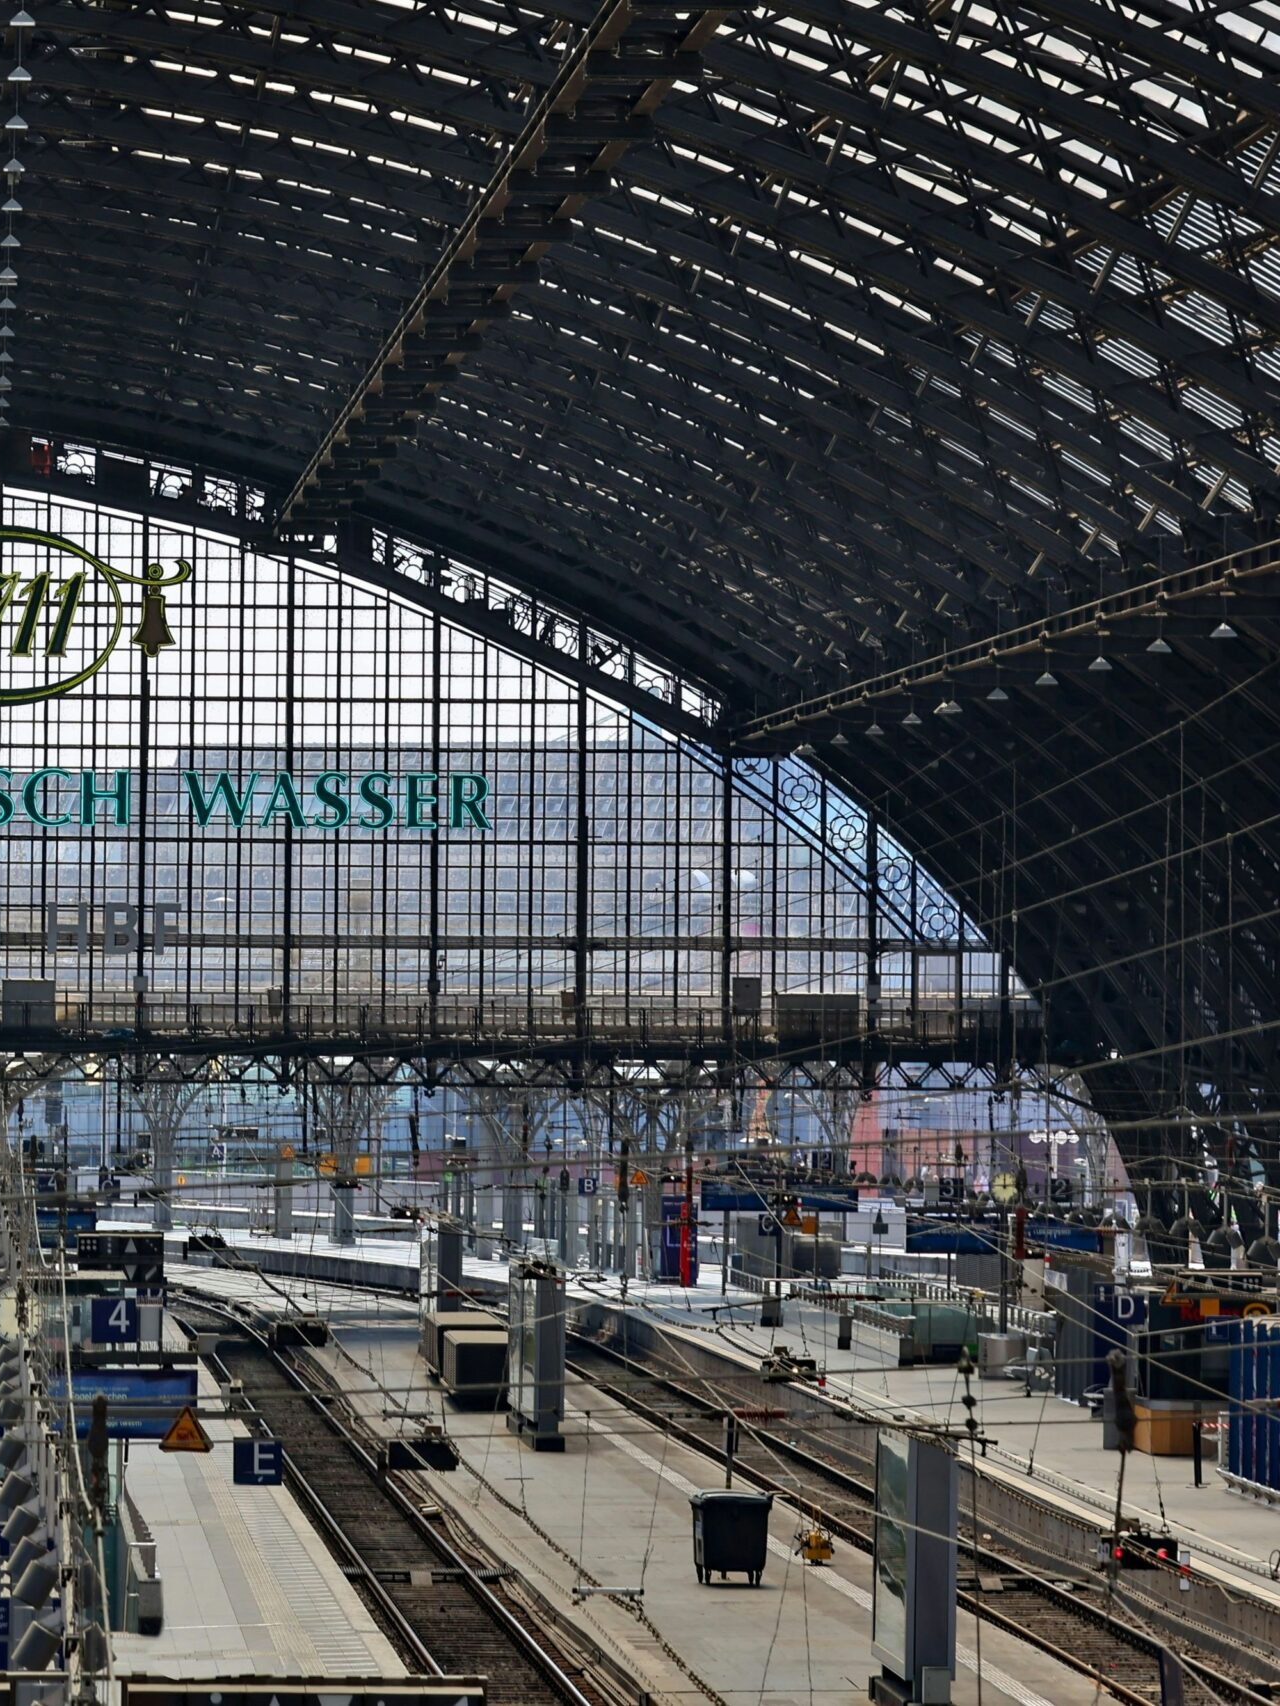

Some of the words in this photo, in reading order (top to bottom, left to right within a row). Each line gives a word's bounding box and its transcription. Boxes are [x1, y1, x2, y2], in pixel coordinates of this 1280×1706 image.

[184, 770, 493, 831] WASSER
[47, 901, 182, 956] HBF
[211, 1146, 221, 1158] A
[584, 1178, 594, 1193] B
[941, 1178, 954, 1198] 3
[1054, 1179, 1067, 1198] 2
[761, 1214, 774, 1232] C
[108, 1299, 130, 1333] 4
[1117, 1294, 1135, 1319] D
[254, 1441, 276, 1475] E
